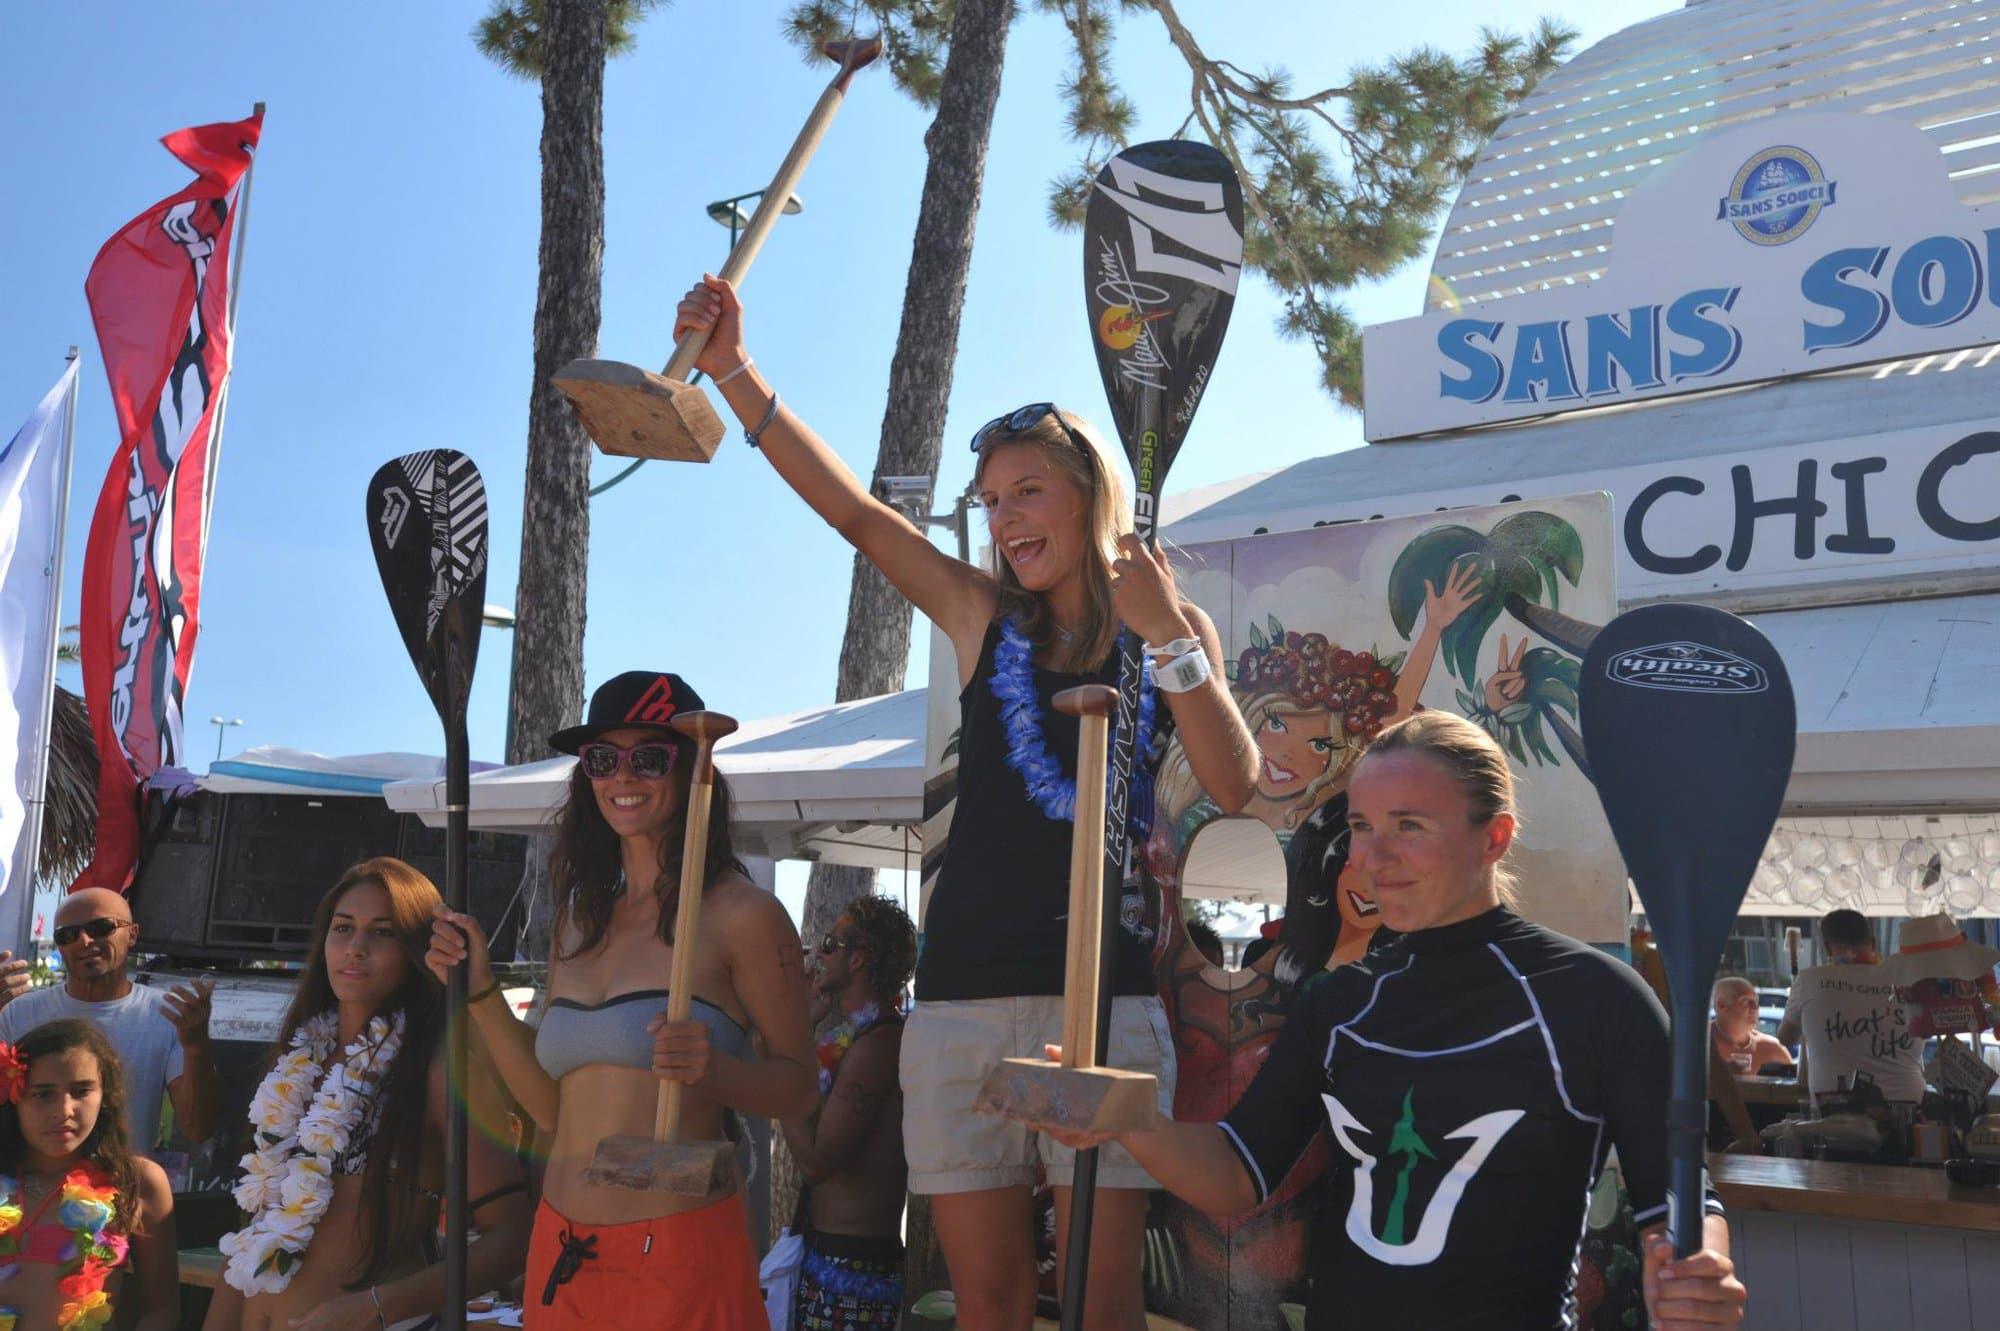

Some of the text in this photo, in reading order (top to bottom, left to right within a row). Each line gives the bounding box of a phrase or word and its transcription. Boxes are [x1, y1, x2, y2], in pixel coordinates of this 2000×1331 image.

[1730, 186, 1825, 217] SANS SOUCI
[1096, 235, 1171, 390] Maui Jim
[1437, 227, 2000, 403] SANS SO
[1621, 657, 1752, 679] Stealth
[1104, 650, 1141, 867] NAISH
[1823, 1007, 1906, 1042] that's
[1871, 1027, 1914, 1059] life
